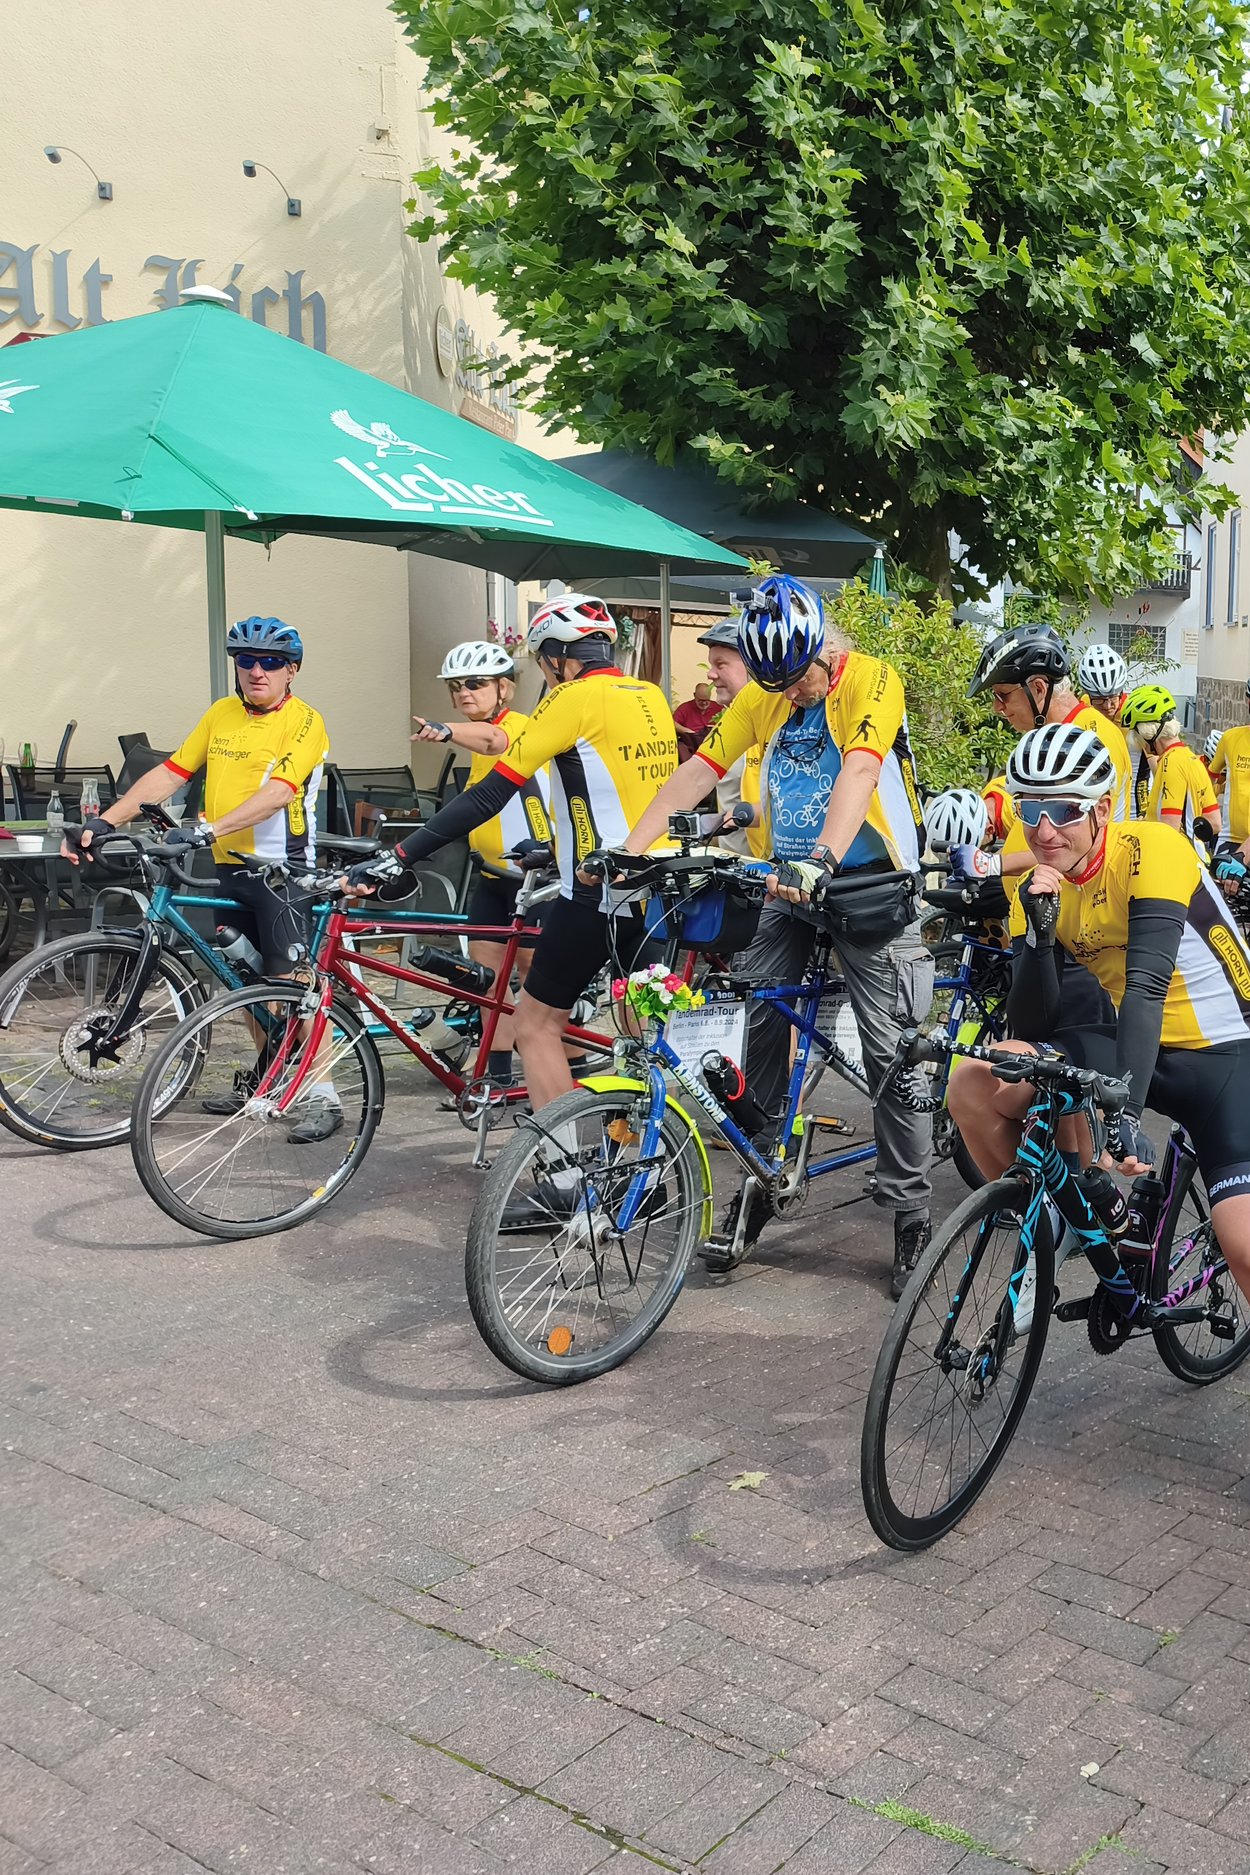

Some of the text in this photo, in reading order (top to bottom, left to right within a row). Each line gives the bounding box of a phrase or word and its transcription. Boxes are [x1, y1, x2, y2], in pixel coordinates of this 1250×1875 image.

[333, 456, 550, 523] Licher
[577, 816, 590, 847] HORN
[1225, 945, 1245, 978] HORN
[673, 1062, 728, 1124] KENSTONE
